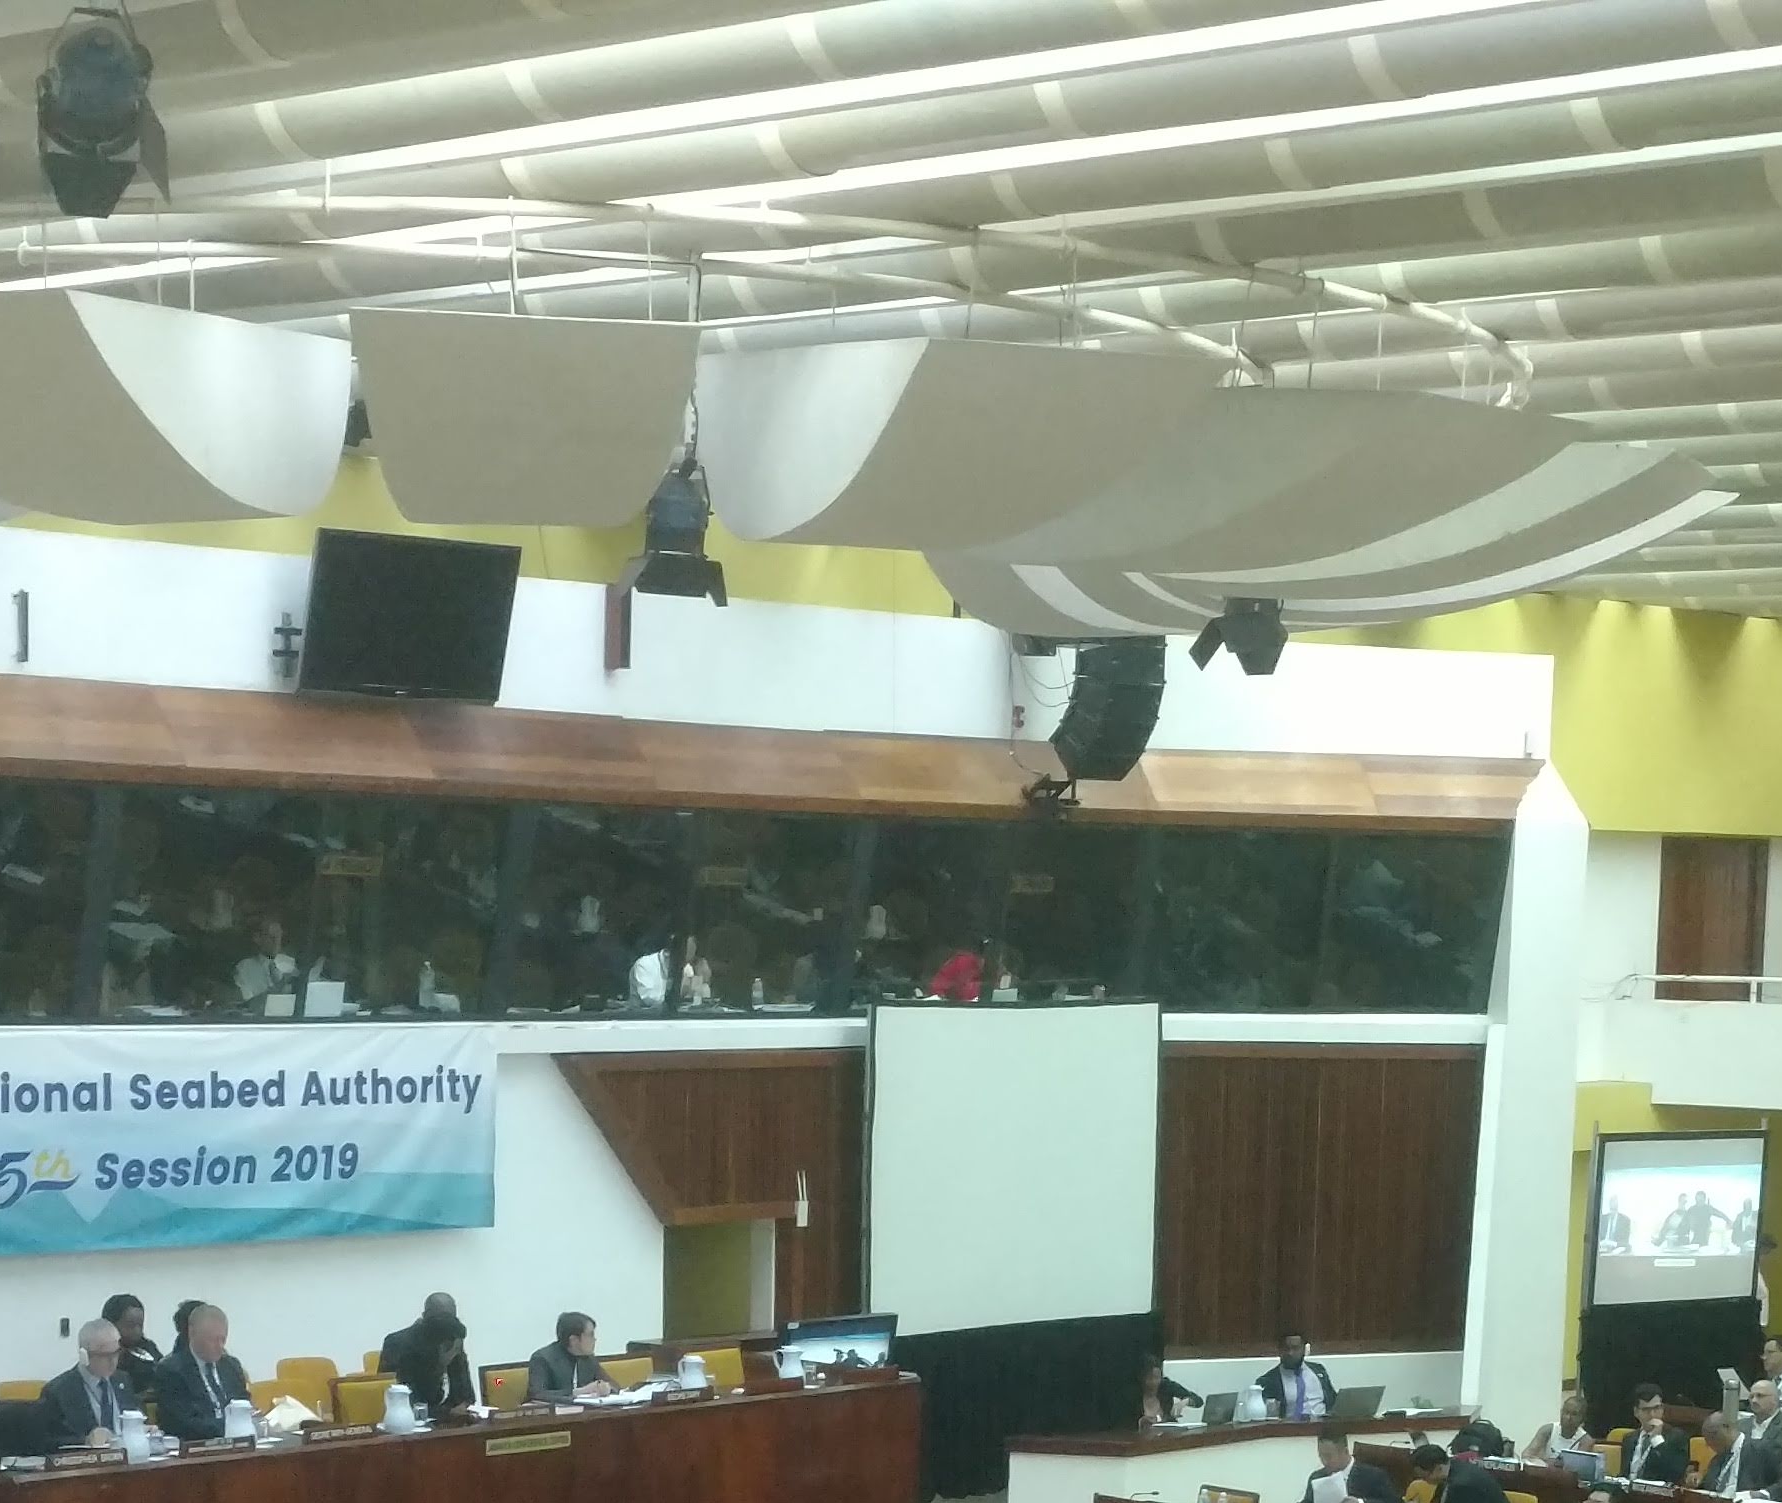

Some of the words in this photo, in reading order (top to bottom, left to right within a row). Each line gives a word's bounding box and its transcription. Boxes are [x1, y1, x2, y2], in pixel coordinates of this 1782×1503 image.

[129, 1070, 286, 1110] Seabed
[300, 1065, 482, 1114] Authority
[95, 1146, 257, 1190] Session
[270, 1143, 359, 1183] 2019
